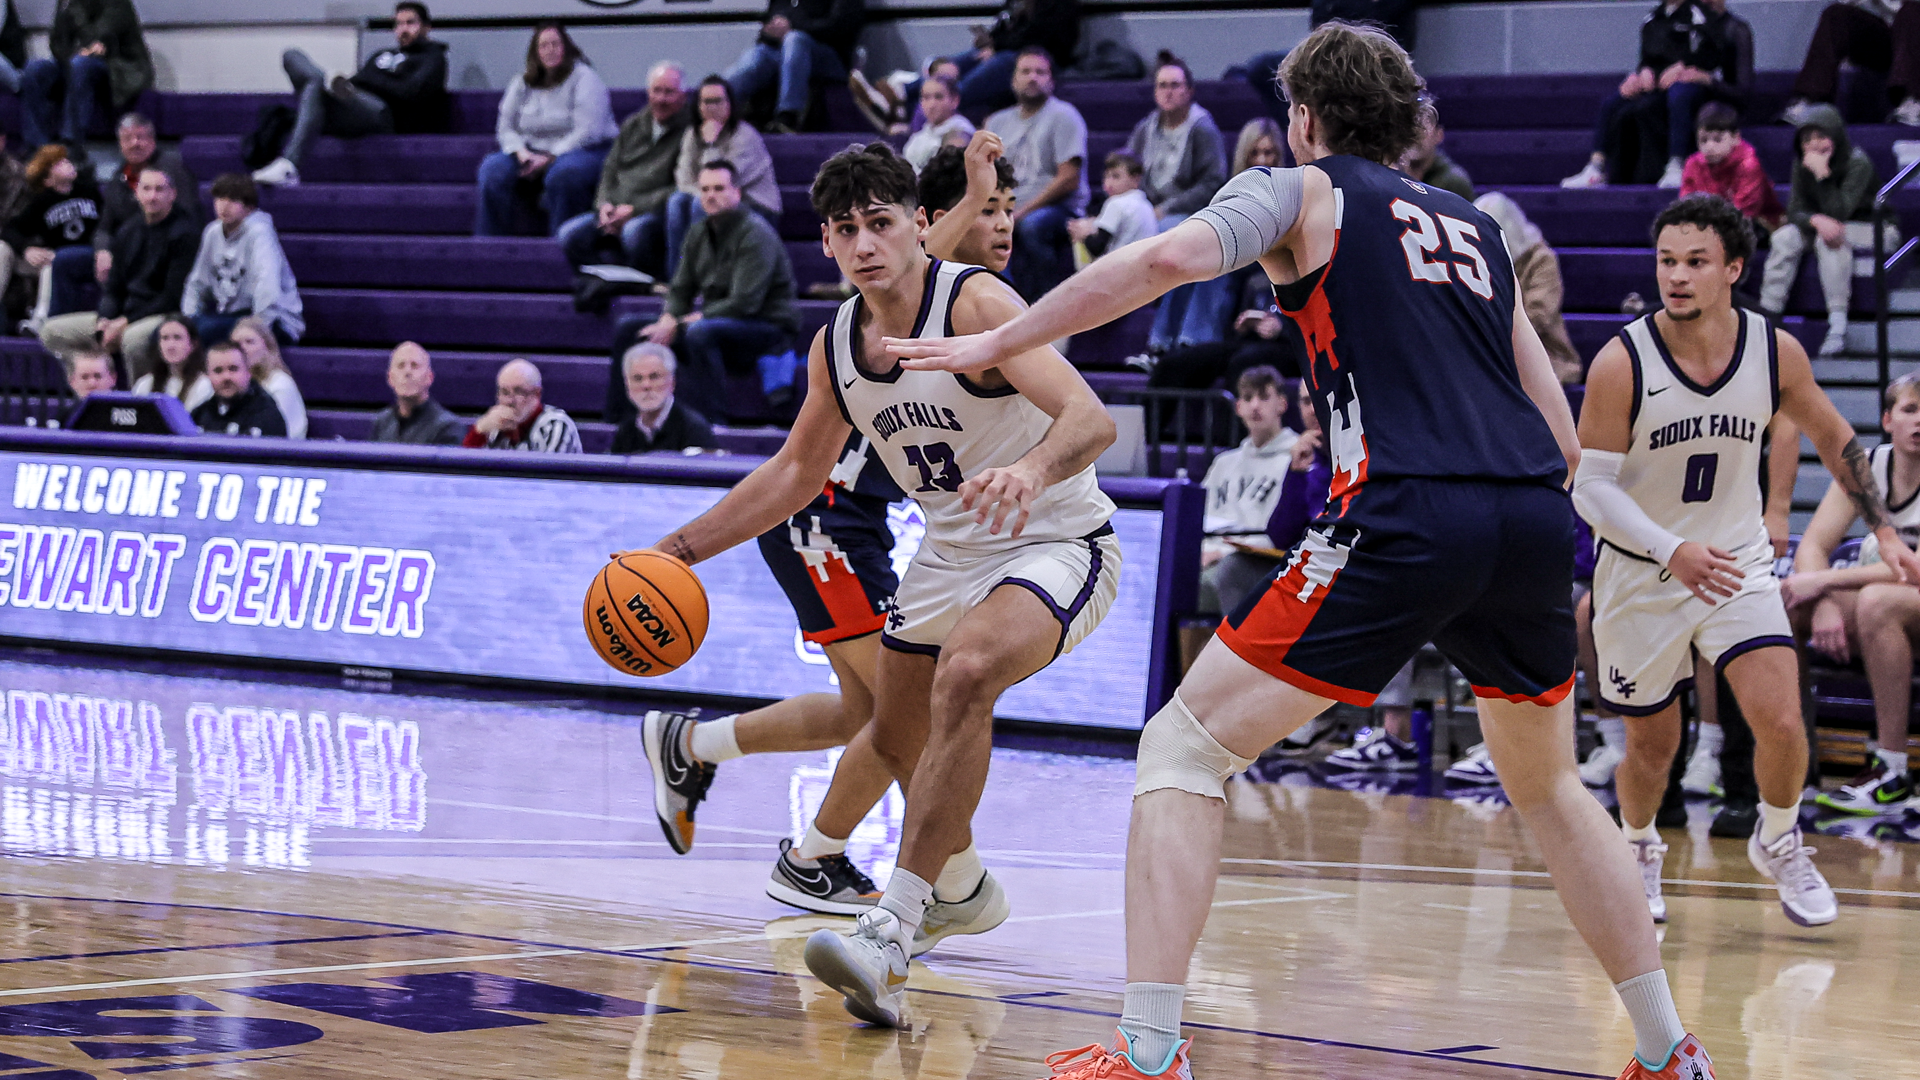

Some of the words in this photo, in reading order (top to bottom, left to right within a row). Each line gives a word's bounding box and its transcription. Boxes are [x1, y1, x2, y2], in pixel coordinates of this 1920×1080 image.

[1389, 197, 1494, 301] 25
[872, 404, 908, 442] SIOUX
[902, 402, 964, 432] FALLS
[1649, 415, 1703, 451] SIOUX
[902, 441, 965, 493] 13
[1681, 452, 1719, 504] 0
[13, 462, 187, 518] WELCOME
[195, 472, 245, 521] TO
[254, 475, 327, 527] THE
[189, 536, 437, 639] CENTER
[626, 592, 677, 649] NCAA
